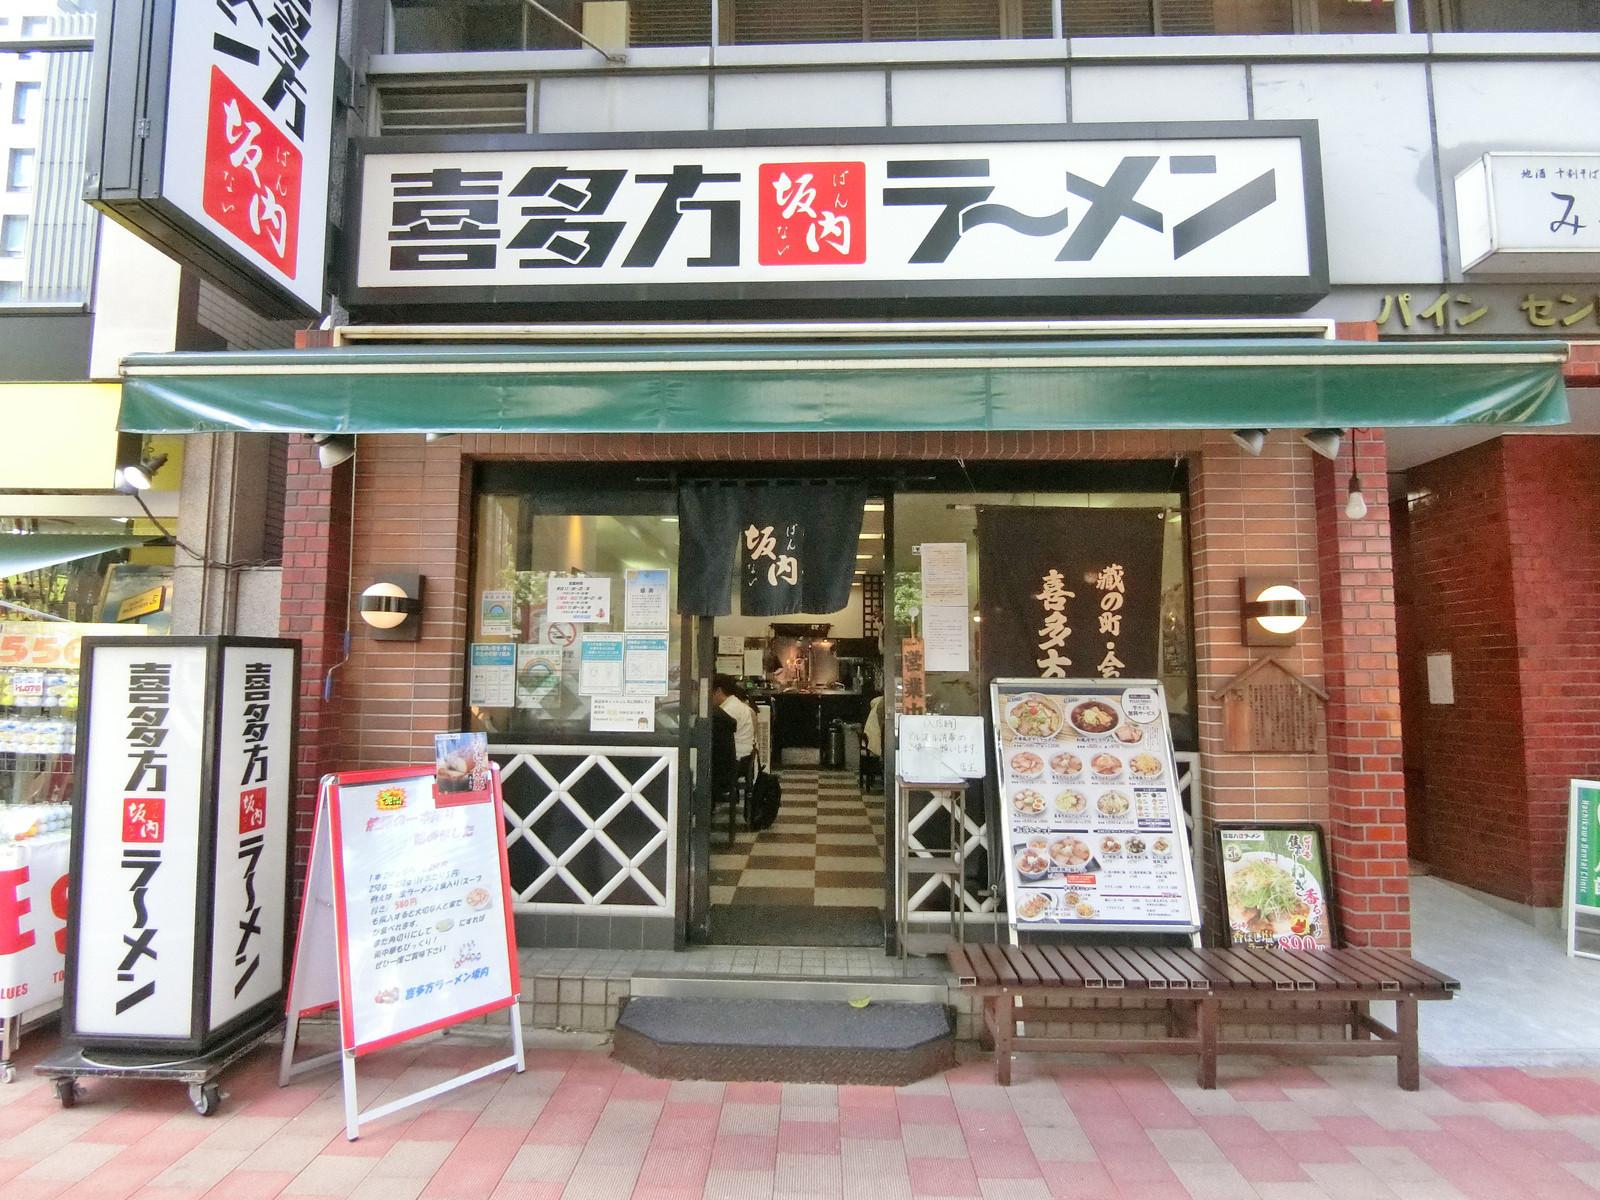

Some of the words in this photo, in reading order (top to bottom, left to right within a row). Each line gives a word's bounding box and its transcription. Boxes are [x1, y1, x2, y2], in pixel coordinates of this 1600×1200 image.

[261, 0, 313, 143] 多方
[388, 164, 741, 270] 喜多方
[1521, 168, 1546, 180] 地酒
[1376, 292, 1490, 328] パイン
[1520, 292, 1600, 328] セン
[1035, 568, 1076, 679] 喜多方
[124, 662, 172, 792] 喜多方
[241, 663, 272, 786] 喜多方
[1580, 844, 1589, 869] Dental
[1580, 871, 1588, 894] Clinic
